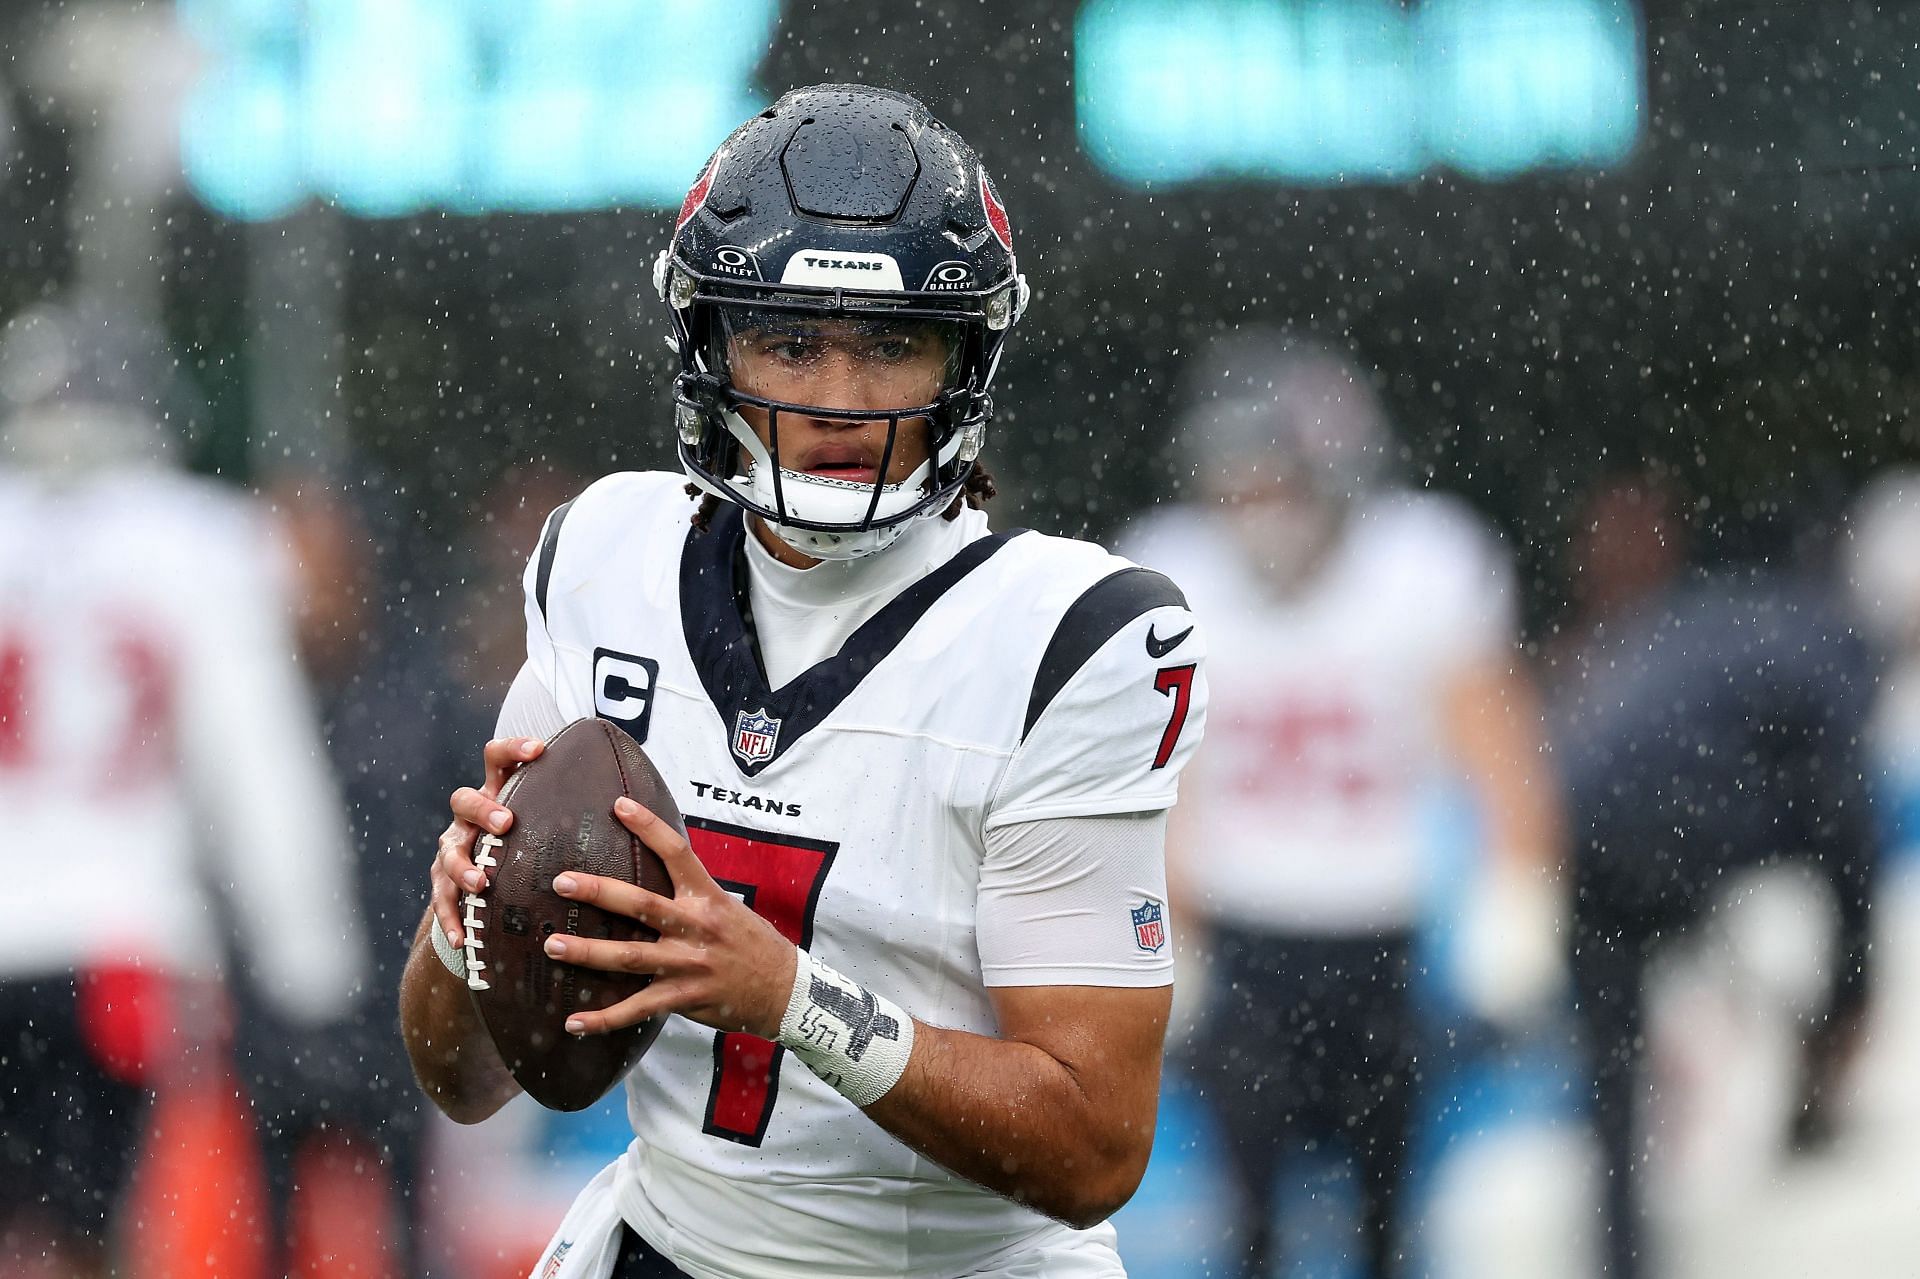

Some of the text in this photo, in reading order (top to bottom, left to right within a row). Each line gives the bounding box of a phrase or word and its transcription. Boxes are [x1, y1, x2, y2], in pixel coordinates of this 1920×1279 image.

[711, 263, 755, 276] OAKLEY
[804, 258, 884, 271] TEXANS
[929, 281, 974, 292] OAKLEY
[594, 655, 648, 721] C
[1151, 663, 1196, 770] 7
[739, 732, 769, 757] NFL
[690, 780, 802, 817] TEXANS
[1138, 925, 1165, 947] NFL
[682, 813, 839, 1148] 7
